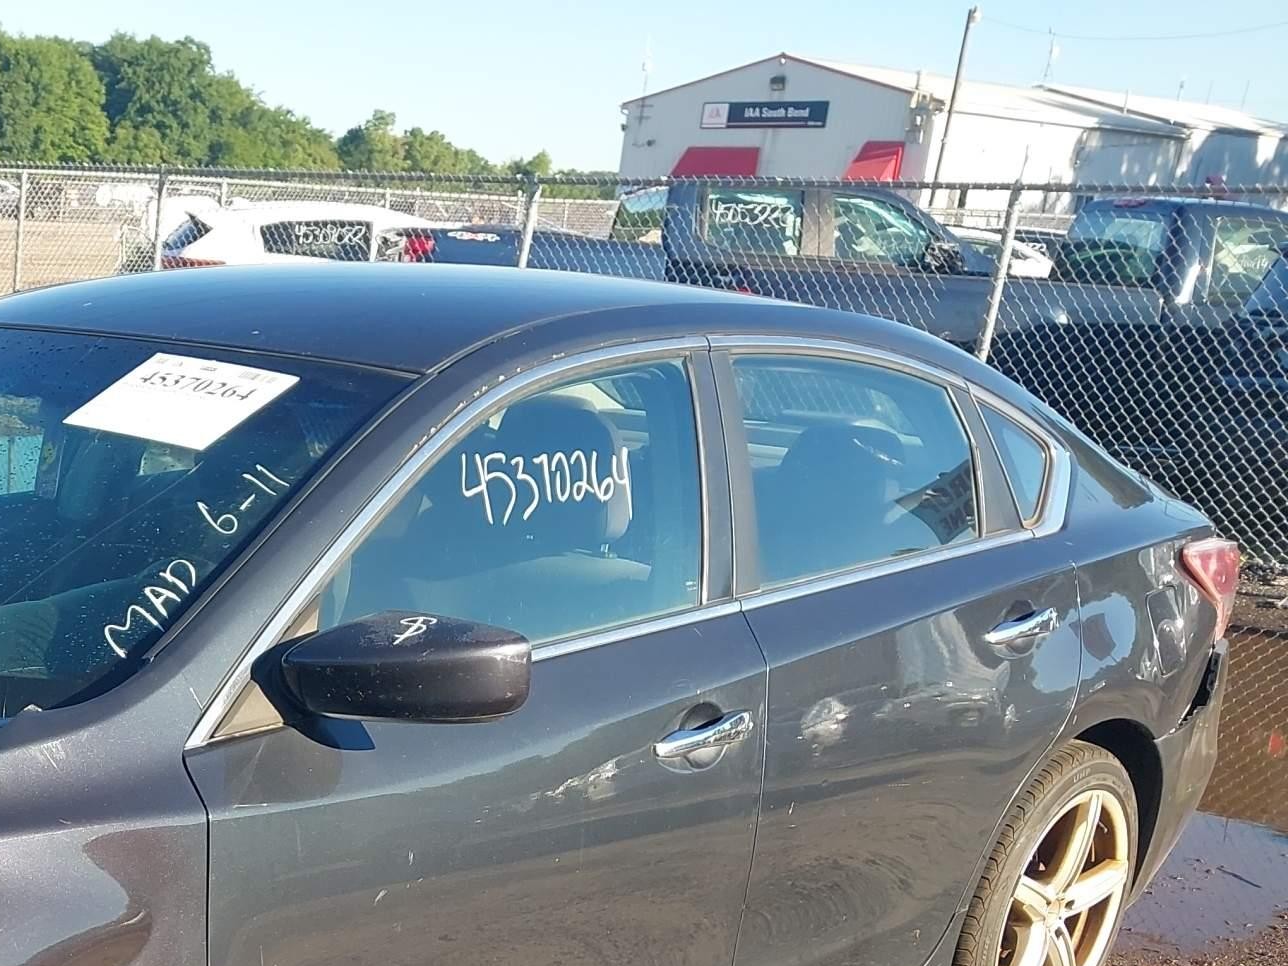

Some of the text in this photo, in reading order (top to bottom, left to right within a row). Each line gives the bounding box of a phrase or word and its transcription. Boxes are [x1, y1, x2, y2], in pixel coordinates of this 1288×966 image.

[761, 106, 786, 118] South
[787, 106, 810, 118] Bend
[139, 371, 257, 401] 45370264
[461, 446, 633, 526] 45370264
[105, 464, 290, 659] MAD 6-11
